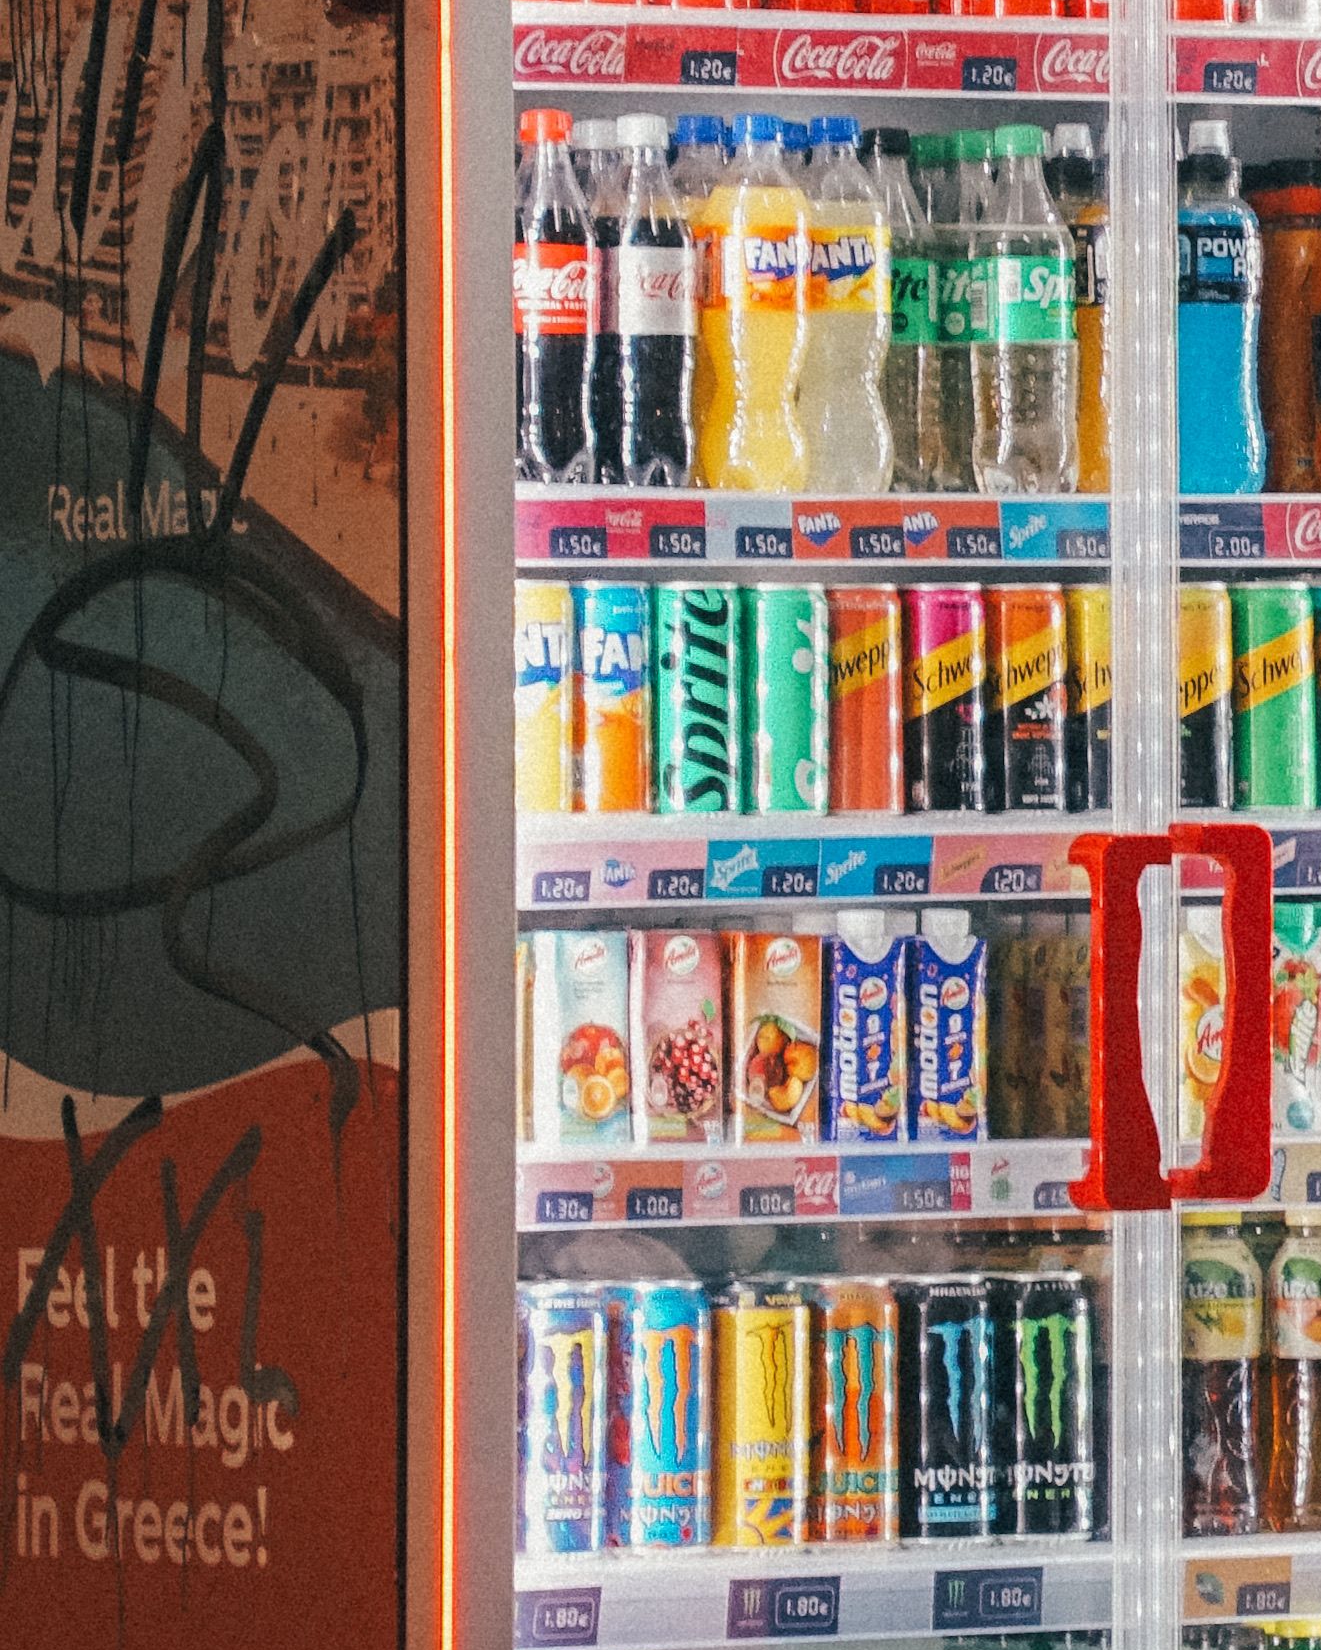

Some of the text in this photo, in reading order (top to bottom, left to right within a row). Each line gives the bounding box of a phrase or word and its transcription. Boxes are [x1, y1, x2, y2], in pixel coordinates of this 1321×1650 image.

[515, 28, 625, 77] Coca-Cola
[780, 33, 898, 82] Coca-Cola
[688, 57, 733, 81] 1.20€
[969, 60, 1016, 87] 1.20€
[1210, 66, 1254, 91] 1.20€
[47, 478, 129, 542] Real
[557, 531, 602, 556] 1.50€
[657, 530, 702, 554] 1.50€
[743, 531, 787, 555] 1.50€
[858, 530, 902, 555] 1.50€
[954, 531, 999, 555] 1.50€
[1214, 535, 1261, 557] 2.00€
[540, 875, 585, 899] 1.20€
[656, 873, 700, 898] 1.20€
[770, 872, 814, 896] 1.20€
[882, 870, 926, 893] 1.20€
[832, 983, 859, 1102] motion
[914, 983, 939, 1101] motion
[633, 1193, 680, 1217] 1.00€
[747, 1191, 792, 1216] 1.00€
[19, 1362, 296, 1468] Real Magic
[16, 1474, 269, 1569] in Greece!
